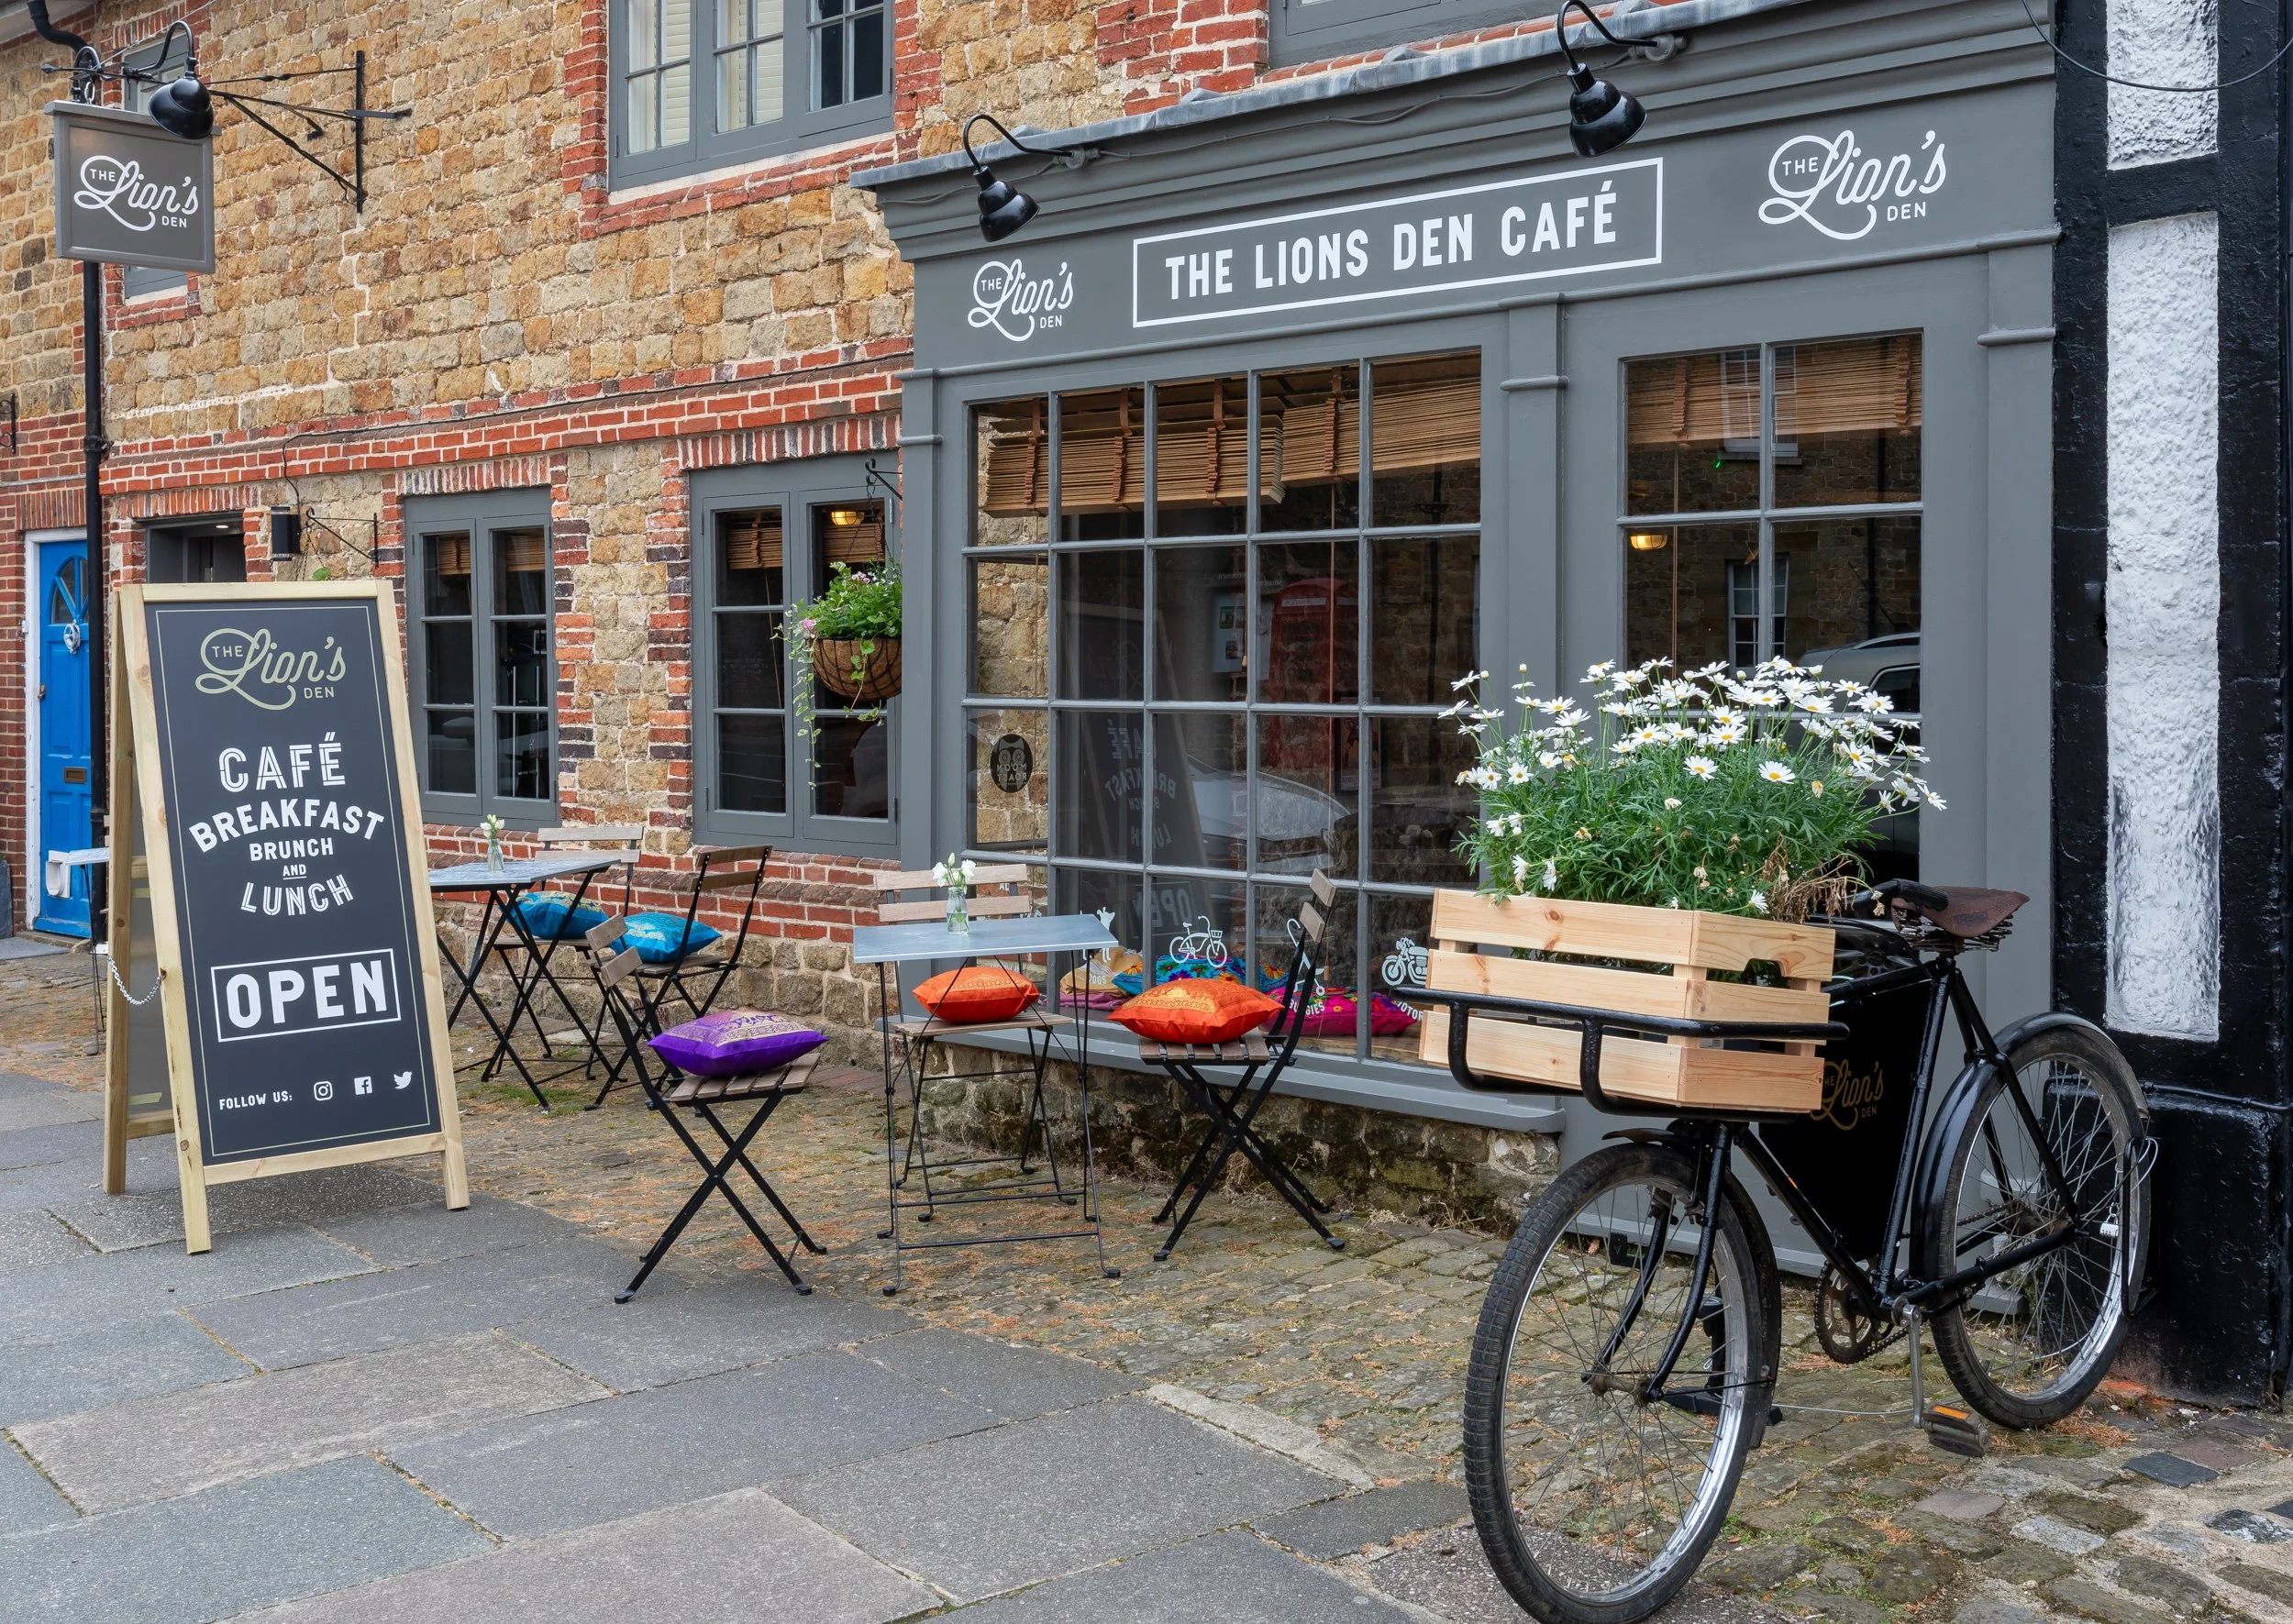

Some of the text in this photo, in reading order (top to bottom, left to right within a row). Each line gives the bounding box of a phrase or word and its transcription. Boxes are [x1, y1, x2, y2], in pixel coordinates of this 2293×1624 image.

[73, 155, 199, 231] THE Lion's
[1758, 129, 1946, 240] THE Lion's
[161, 215, 187, 228] DEN
[1887, 201, 1926, 221] DEN
[1166, 180, 1617, 300] THE LIONS DEN CAFÉ
[968, 258, 1074, 342] THE Lion's
[1039, 315, 1062, 328] DEN
[195, 628, 346, 711] THE Lion's
[304, 687, 335, 699] DEN
[218, 731, 346, 792] CAFÉ
[189, 799, 384, 853] BREAKFAST
[249, 837, 334, 861] BRUNCH
[282, 864, 307, 877] AND
[240, 874, 354, 916] LUNCH
[226, 959, 387, 1029] OPEN
[1823, 1075, 1835, 1088] HE
[219, 1093, 267, 1110] FOLLOW
[272, 1090, 293, 1103] US:
[1861, 1105, 1878, 1119] DEN
